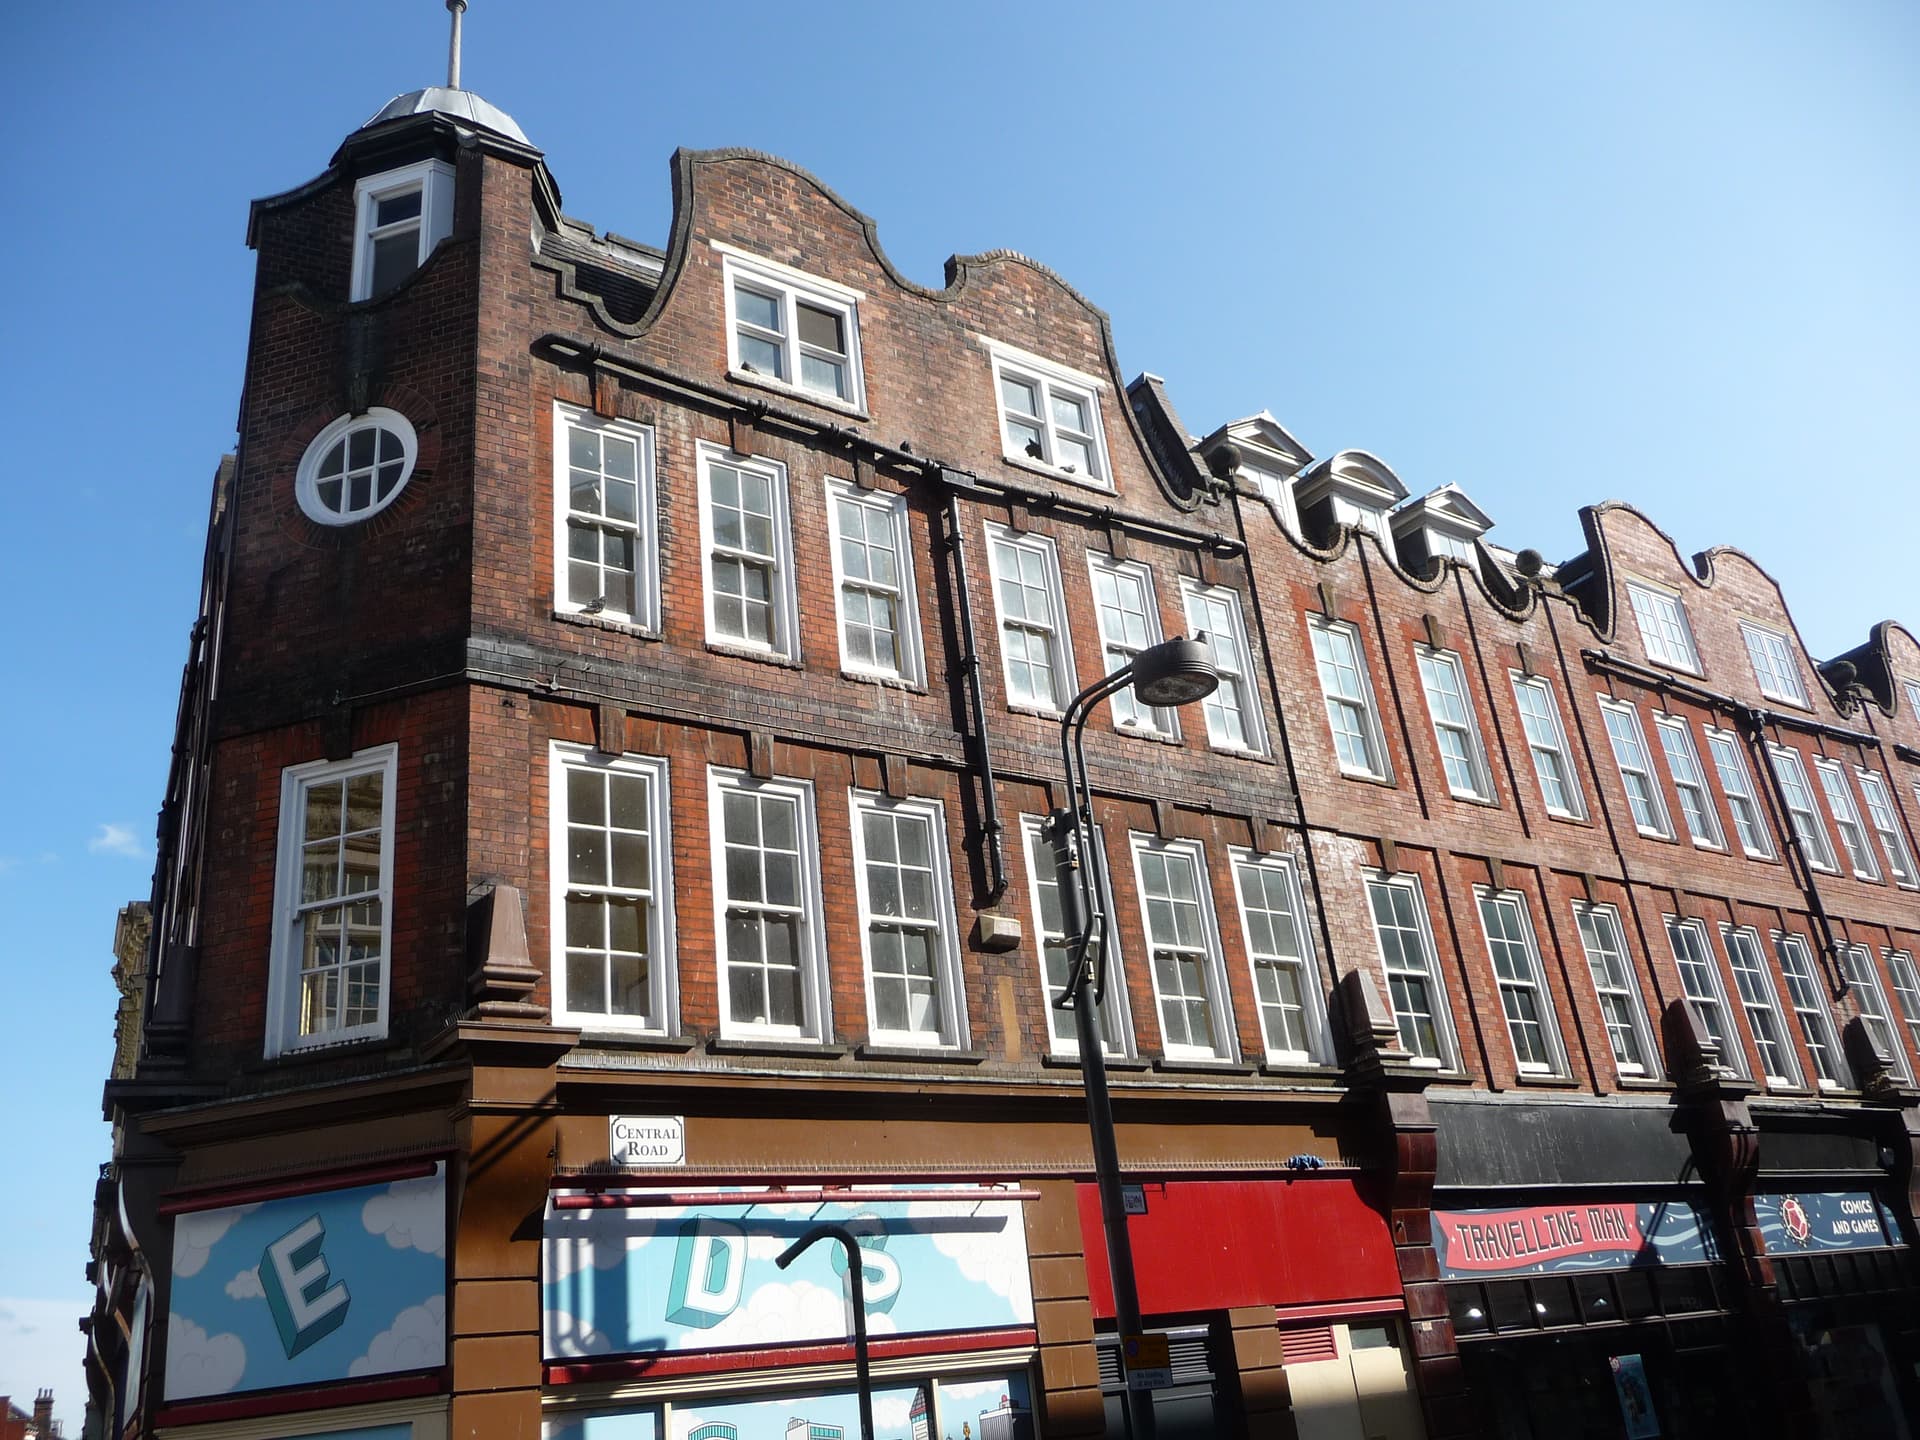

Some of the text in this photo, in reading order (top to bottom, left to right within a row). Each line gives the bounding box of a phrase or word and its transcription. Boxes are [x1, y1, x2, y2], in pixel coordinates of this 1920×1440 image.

[615, 1124, 679, 1140] CENTRAL
[627, 1141, 668, 1156] ROAD
[1840, 1200, 1873, 1214] COMICS
[1455, 1207, 1630, 1261] TRAVELLING MAN
[1832, 1219, 1879, 1235] AND GAMES
[258, 1212, 351, 1360] E
